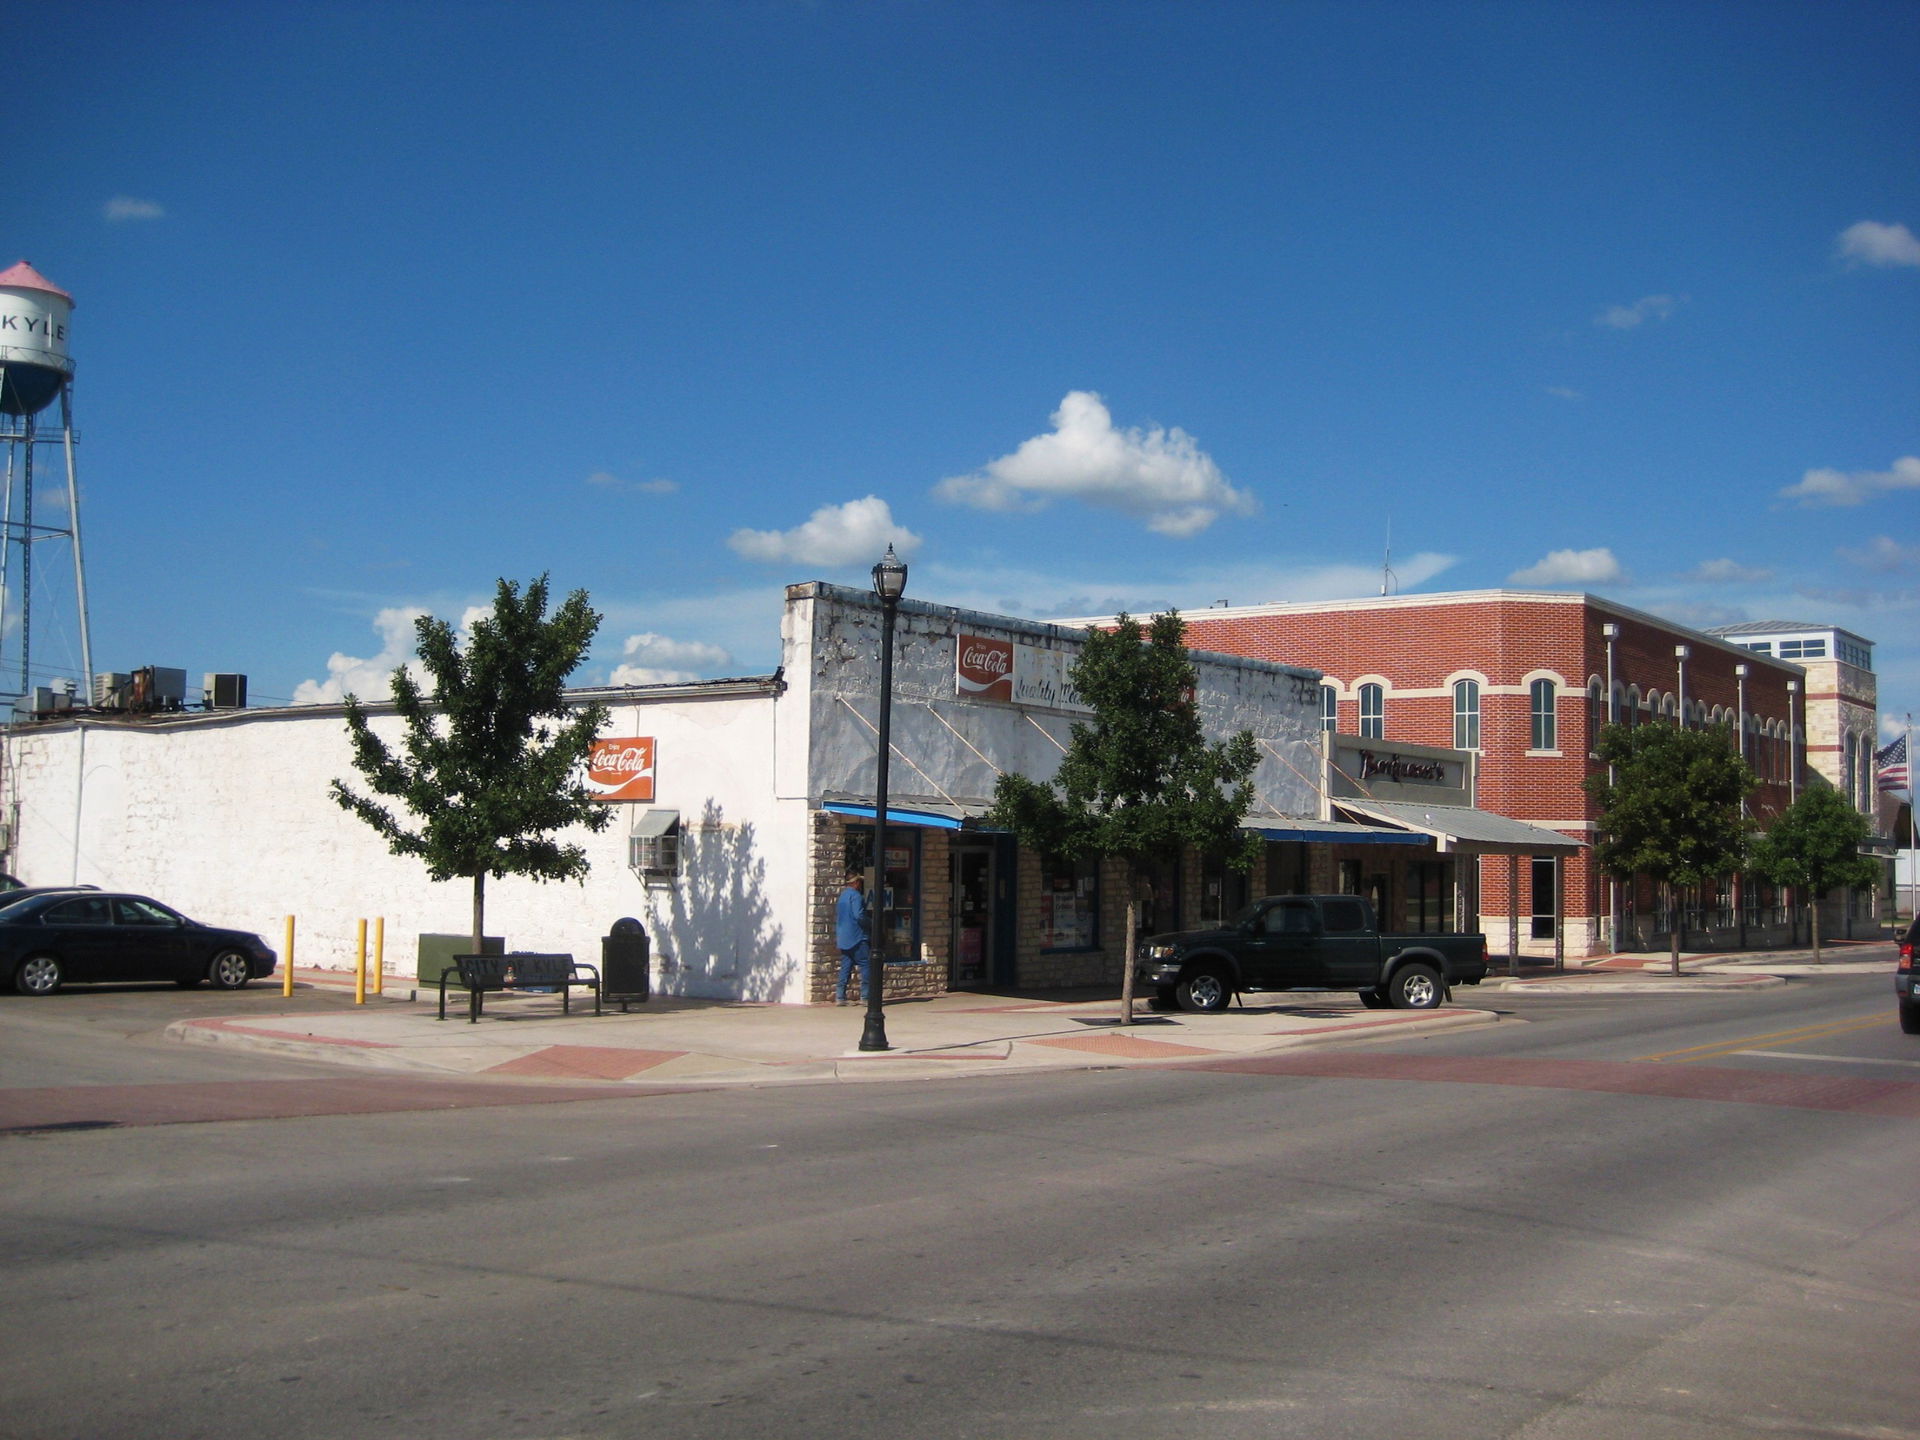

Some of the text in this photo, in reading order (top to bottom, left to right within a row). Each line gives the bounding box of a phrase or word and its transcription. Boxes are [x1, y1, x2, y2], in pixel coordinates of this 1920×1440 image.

[2, 315, 65, 341] KYLE
[963, 646, 1008, 673] Coca-Cola
[592, 747, 648, 772] Coca-Cola
[465, 959, 498, 975] CITY
[534, 958, 570, 973] KYLE
